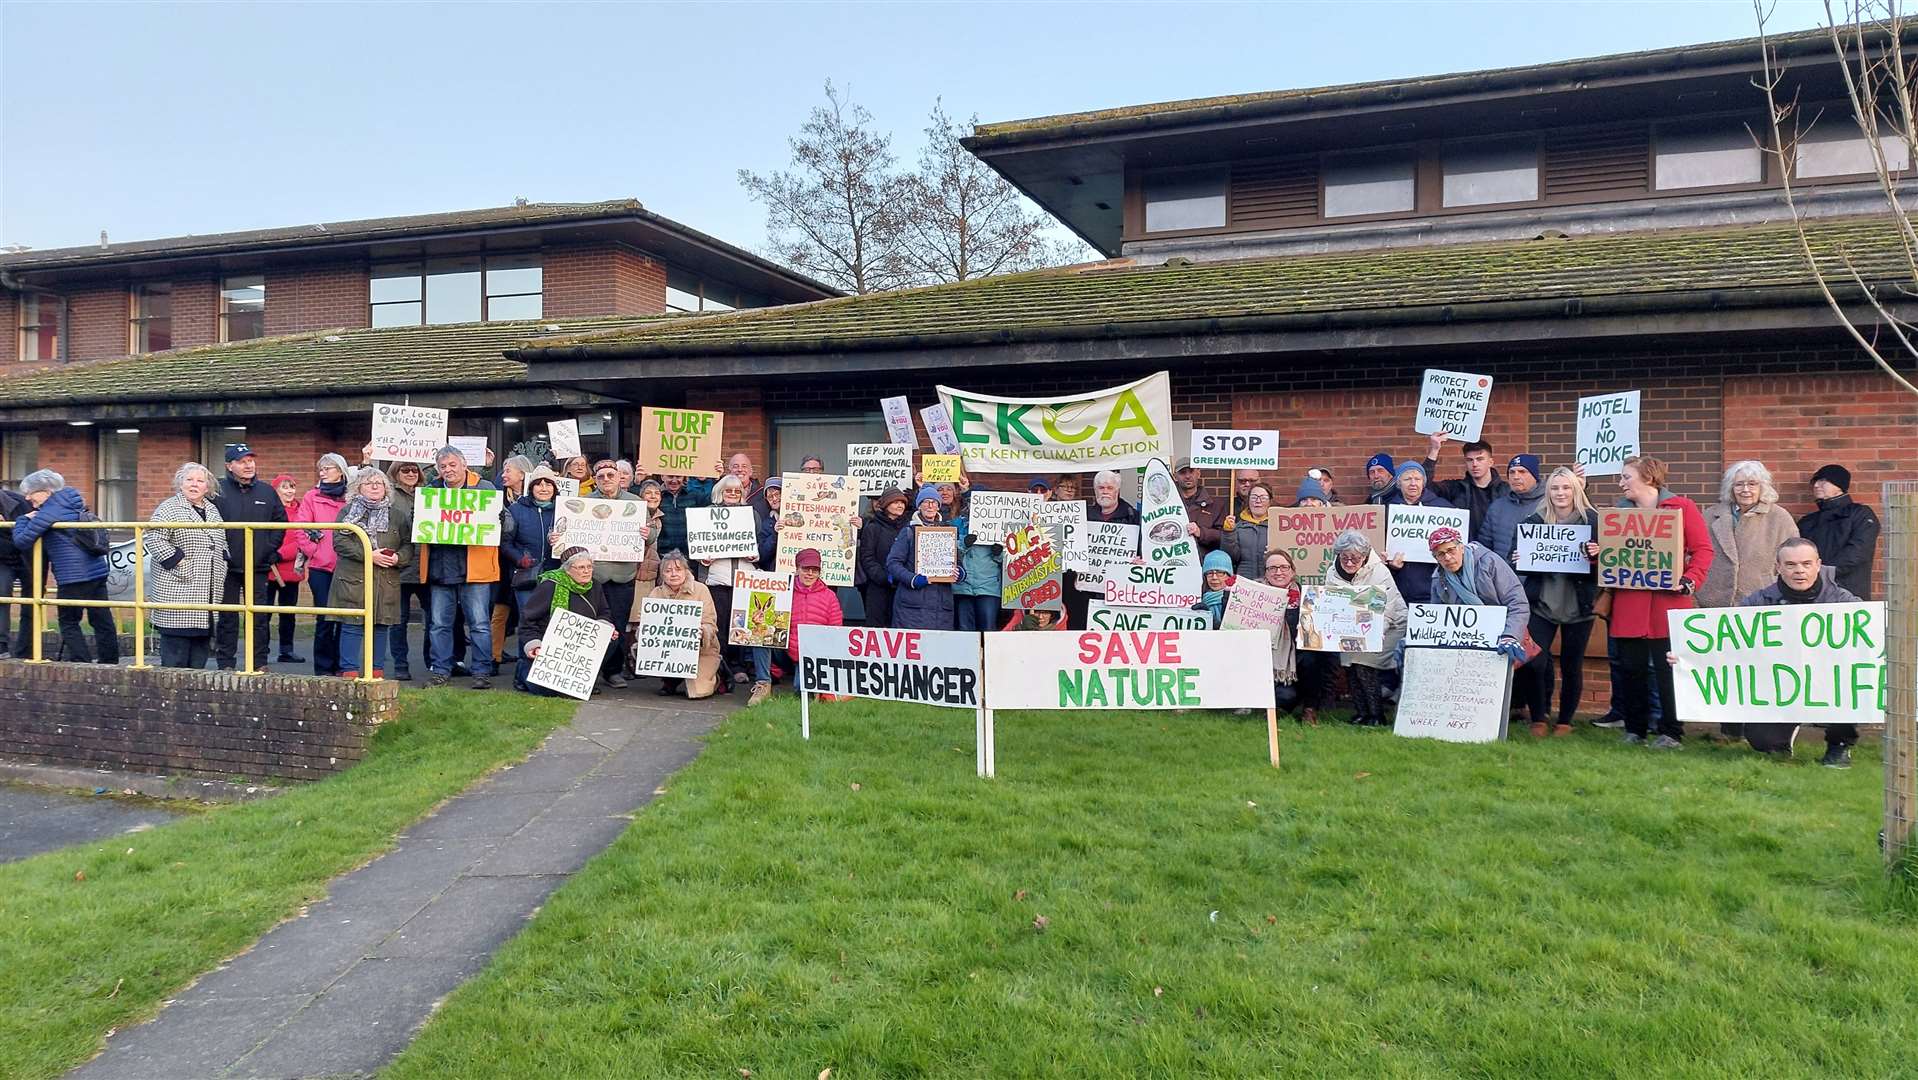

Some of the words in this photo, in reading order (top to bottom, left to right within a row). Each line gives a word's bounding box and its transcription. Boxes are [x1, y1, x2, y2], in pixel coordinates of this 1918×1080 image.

[1430, 374, 1469, 388] PROTECT
[1442, 387, 1483, 401] NATURE
[1426, 397, 1443, 405] AND
[1456, 401, 1477, 411] WILL
[1582, 398, 1632, 418] HOTEL
[1424, 407, 1470, 422] PROTECT
[653, 410, 714, 434] TURF
[1441, 420, 1467, 436] YOU!
[1601, 417, 1611, 429] IS
[376, 436, 394, 444] THE
[400, 439, 436, 447] MIGHTY
[661, 434, 701, 452] NOT
[1203, 435, 1262, 451] STOP
[1596, 430, 1616, 443] NO
[853, 446, 878, 455] KEEP
[883, 446, 905, 455] YOUR
[962, 447, 985, 458] AST
[991, 448, 1028, 460] KENT
[1033, 446, 1095, 461] CLIMATE
[1099, 440, 1160, 457] ACTION
[1578, 445, 1632, 465] CHOKE
[658, 454, 698, 469] SURF
[848, 459, 911, 467] ENVIRONMENTAL
[925, 459, 956, 467] NATURE
[1193, 456, 1275, 466] GREENWASHING
[852, 469, 906, 479] CONSCIENCE
[806, 481, 828, 490] SAVE
[421, 487, 496, 511] TURF
[710, 508, 730, 520] NO
[785, 502, 846, 514] BETTESHANGER
[1033, 503, 1080, 514] SLOGANS
[1142, 506, 1182, 523] WILDLIFE
[441, 509, 473, 523] NOT
[1057, 515, 1080, 524] SAVE
[1332, 512, 1377, 530] WAVE
[1391, 514, 1425, 525] MAIN
[1428, 515, 1462, 528] ROAD
[567, 519, 605, 532] LEAVE
[714, 521, 728, 530] TO
[809, 520, 830, 528] PARK
[1603, 512, 1676, 538] SAVE
[417, 520, 495, 545] SURF
[565, 532, 601, 545] BIRDS
[689, 531, 754, 543] BETTESHANGER
[783, 532, 803, 540] SAVE
[1391, 527, 1430, 540] OVERL
[1006, 526, 1040, 555] OMG
[1625, 538, 1653, 549] OUR
[690, 542, 755, 554] DEVELOPMENT
[1152, 541, 1191, 561] OVER
[1288, 548, 1308, 560] TO
[1600, 548, 1672, 569] GREEN
[825, 573, 852, 582] FAUNA
[1003, 551, 1062, 606] MATERIALISTIC
[1078, 573, 1104, 584] DEAD
[1128, 566, 1176, 584] SAVE
[1602, 568, 1673, 588] SPACE
[1021, 580, 1061, 608] GREED
[1106, 580, 1200, 607] Betteshanger
[644, 602, 701, 617] CONCRETE
[1251, 601, 1263, 609] ON
[664, 616, 673, 625] IS
[1091, 610, 1152, 630] SAVE
[1163, 615, 1206, 630] OUR
[1229, 602, 1281, 625] BETTESHANGER
[1414, 604, 1438, 624] Say
[1444, 606, 1477, 628] NO
[559, 612, 600, 636] POWER
[641, 625, 698, 639] FOREVER
[1409, 626, 1447, 644] Wildlife
[1452, 629, 1485, 640] Needs
[1684, 611, 1783, 654] SAVE
[1801, 609, 1874, 649] OUR
[564, 642, 580, 652] NOT
[663, 639, 699, 651] NATURE
[848, 629, 921, 660] SAVE
[1078, 632, 1182, 664] SAVE
[545, 645, 592, 670] LEISURE
[660, 650, 670, 659] IF
[533, 655, 592, 682] FACILITIES
[638, 660, 664, 671] LEFT
[665, 662, 697, 674] ALONE
[531, 668, 551, 684] FOR
[551, 674, 571, 690] THE
[569, 681, 592, 696] FEW
[803, 656, 977, 706] BETTESHANGER
[1058, 668, 1201, 707] NATURE
[1410, 717, 1439, 726] WHERE
